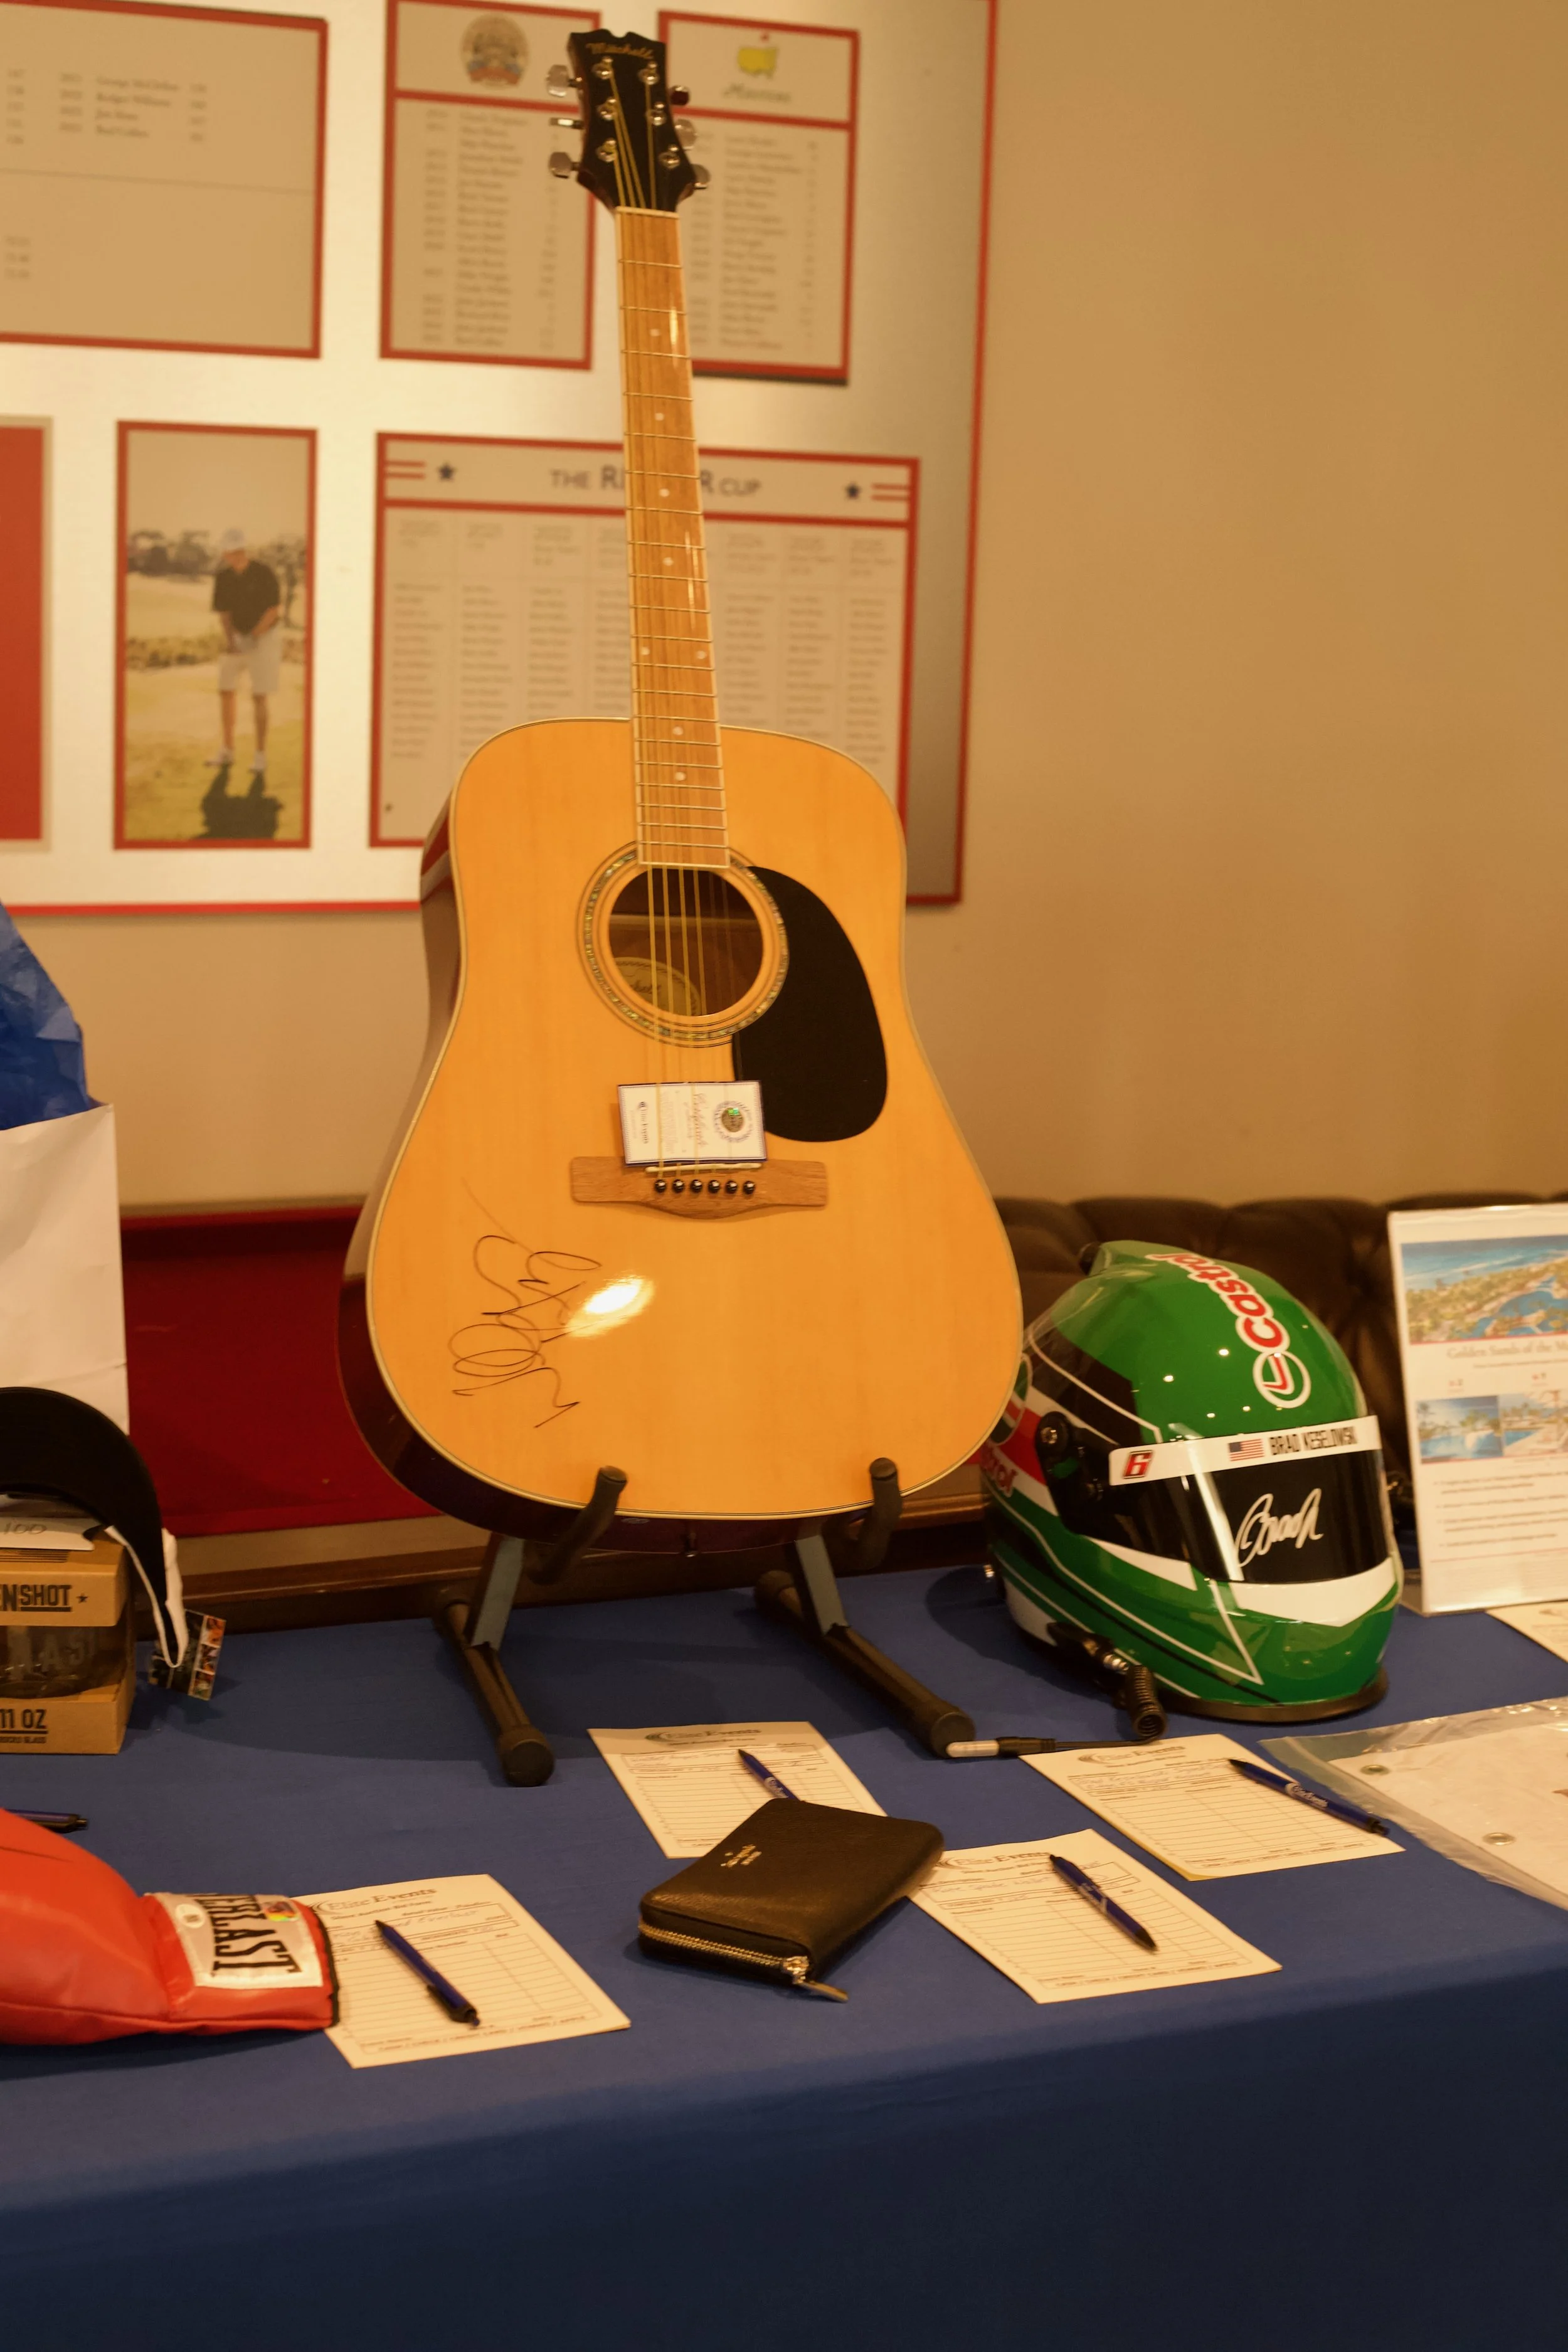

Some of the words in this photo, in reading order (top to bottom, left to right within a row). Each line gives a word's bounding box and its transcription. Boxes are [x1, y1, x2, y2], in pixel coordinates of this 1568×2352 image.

[1145, 1253, 1287, 1351] Castrol
[1268, 1433, 1301, 1455] BRAD
[1123, 1449, 1154, 1479] 6
[0, 1584, 72, 1611] NSHOT
[0, 1708, 15, 1729] 11
[23, 1708, 48, 1730] OZ
[329, 1898, 371, 1911] Elite
[371, 1888, 437, 1904] Events
